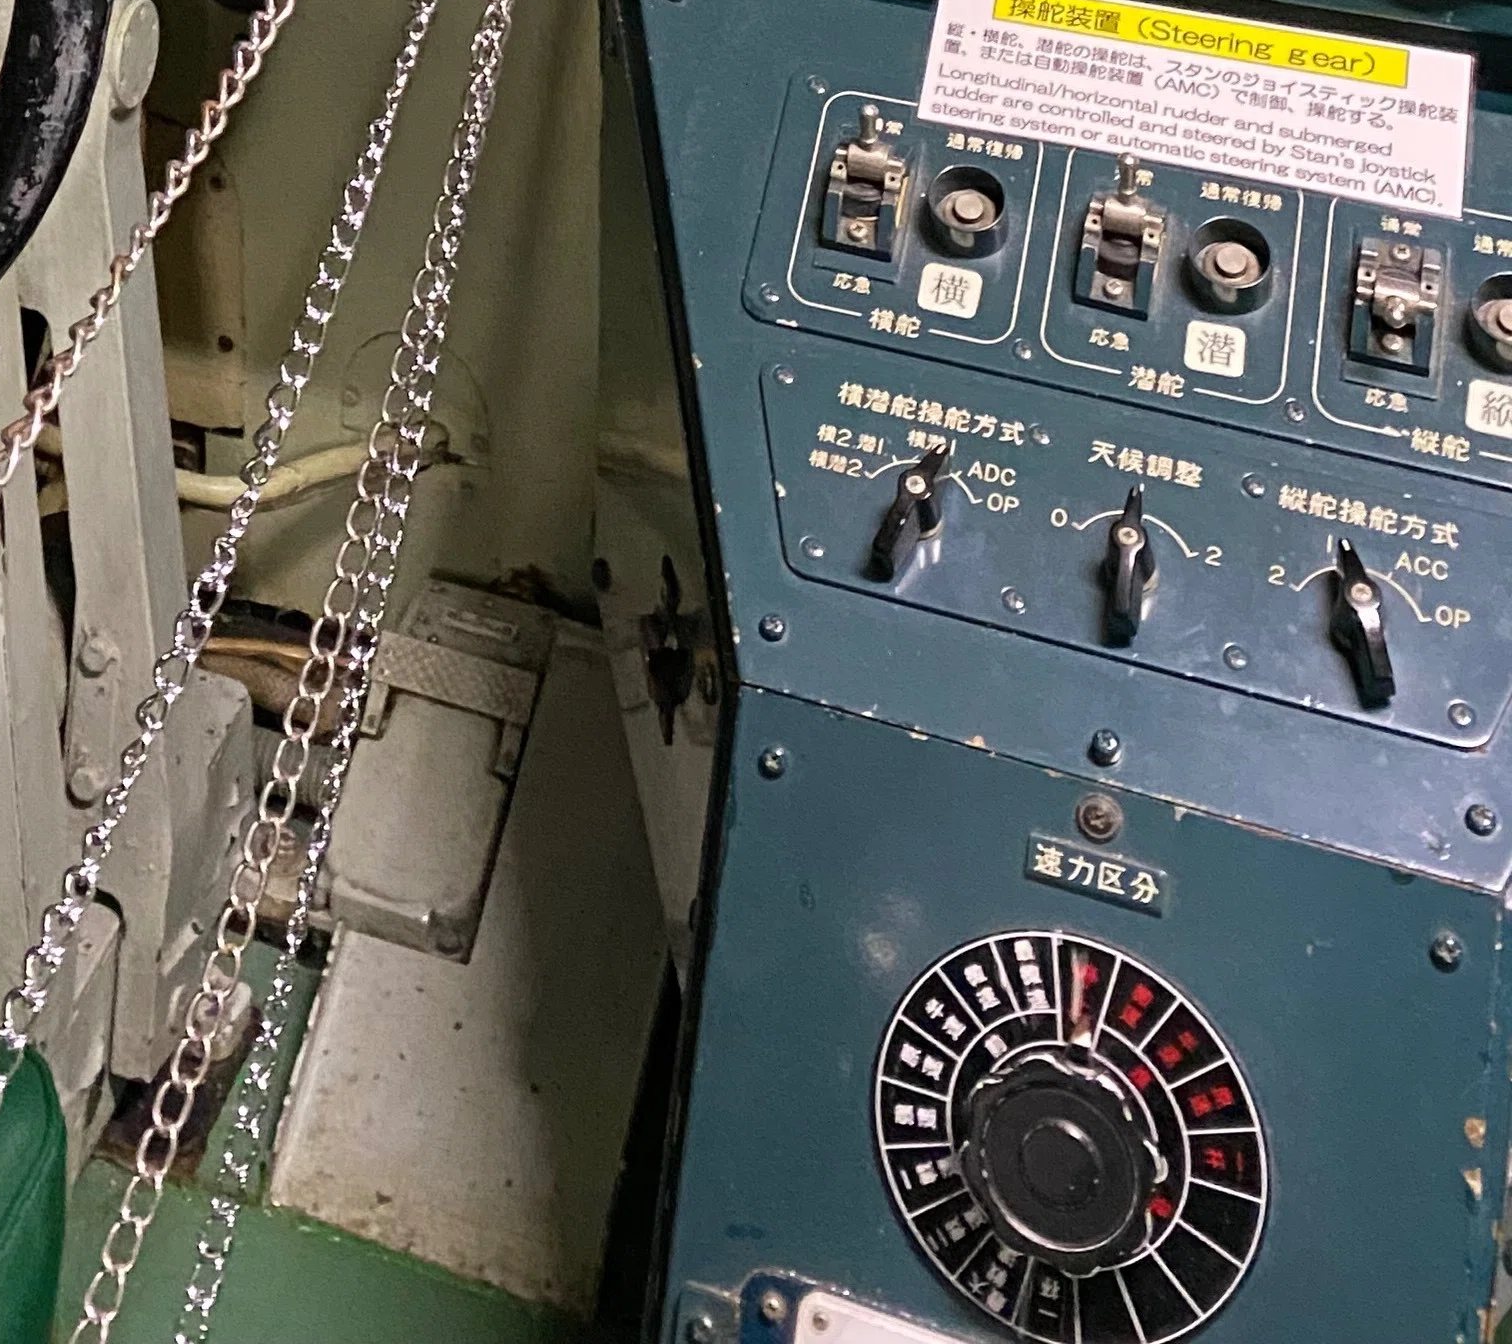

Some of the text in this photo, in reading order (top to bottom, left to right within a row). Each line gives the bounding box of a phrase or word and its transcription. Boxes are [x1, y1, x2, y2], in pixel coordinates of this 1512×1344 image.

[938, 63, 1393, 157] Longitudinal/horizontal rudder and submerged
[934, 84, 1436, 185] rudder are controlled and steered by Stan's joystick
[947, 132, 1024, 160] 通常復帰
[931, 101, 1444, 208] steering system or automatic steering system (AMC).
[1200, 182, 1283, 212] 通常復帰
[933, 272, 970, 309] 横
[869, 308, 922, 339] 横舵
[1197, 330, 1236, 368] 潜
[1128, 365, 1185, 398] 潜舵
[838, 381, 1025, 446] 横潜舵操舵方式
[967, 461, 1016, 487] ADC
[1088, 440, 1203, 488] 天候調整
[987, 492, 1020, 513] OP
[1204, 546, 1223, 567] 2
[1395, 551, 1449, 581] ACC
[1268, 565, 1285, 586] 2
[1435, 606, 1472, 628] OP
[1034, 843, 1160, 903] 速力区分
